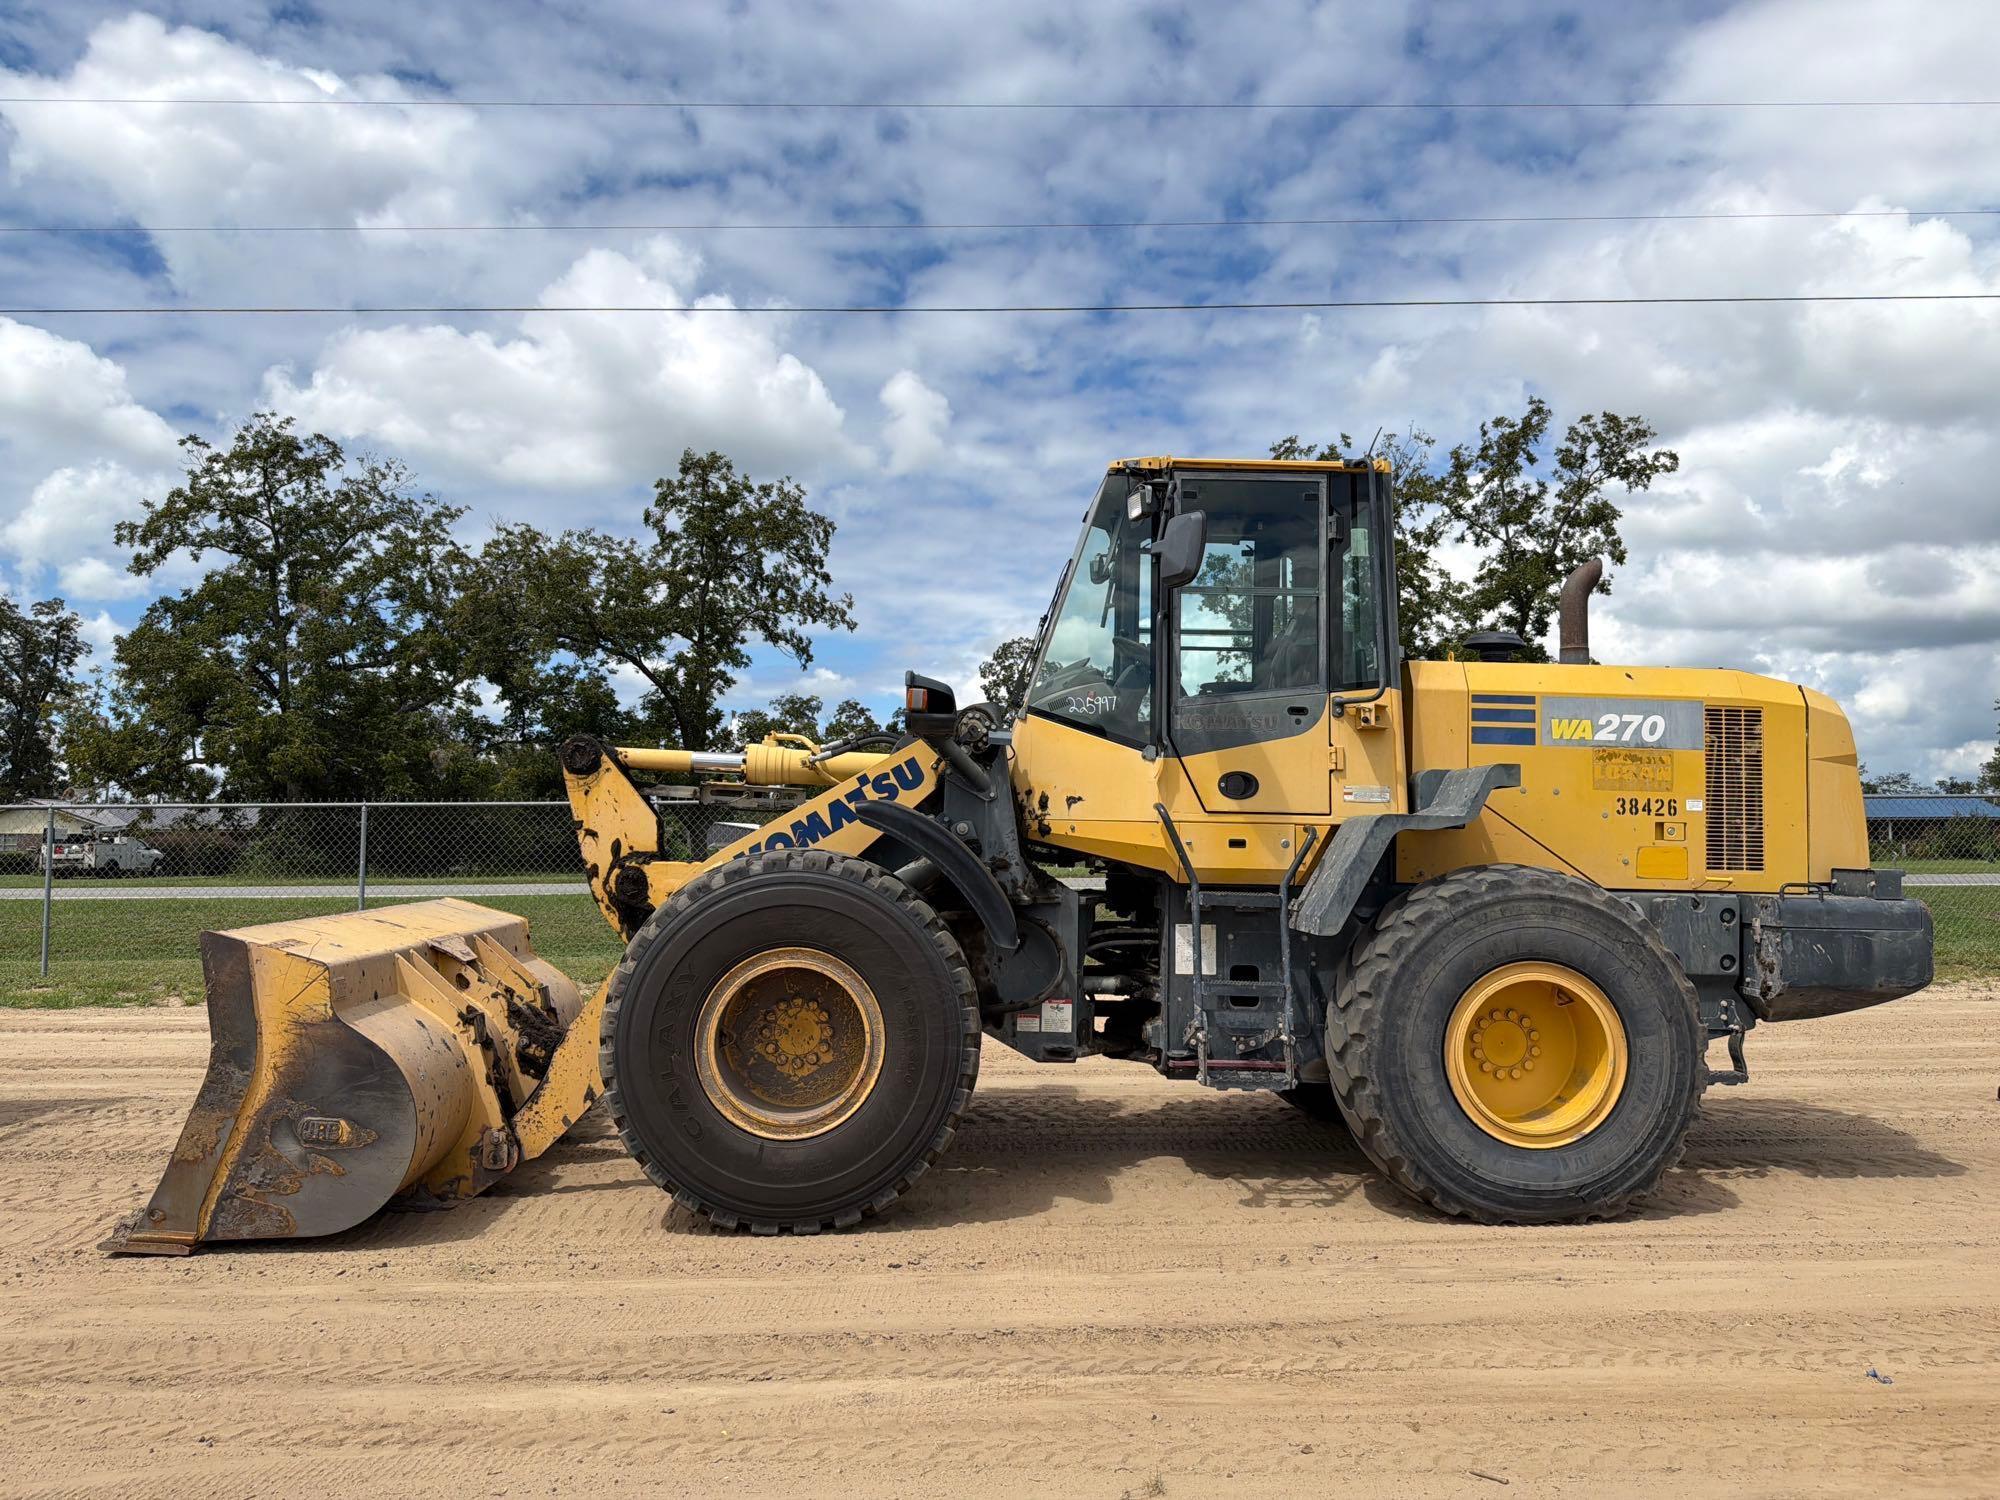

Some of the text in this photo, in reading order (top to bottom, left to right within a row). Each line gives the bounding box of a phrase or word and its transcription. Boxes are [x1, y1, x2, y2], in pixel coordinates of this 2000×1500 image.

[1066, 696, 1117, 714] 225997
[1551, 713, 1666, 743] WA270
[733, 757, 924, 859] OMATSU
[1616, 798, 1677, 817] 38426
